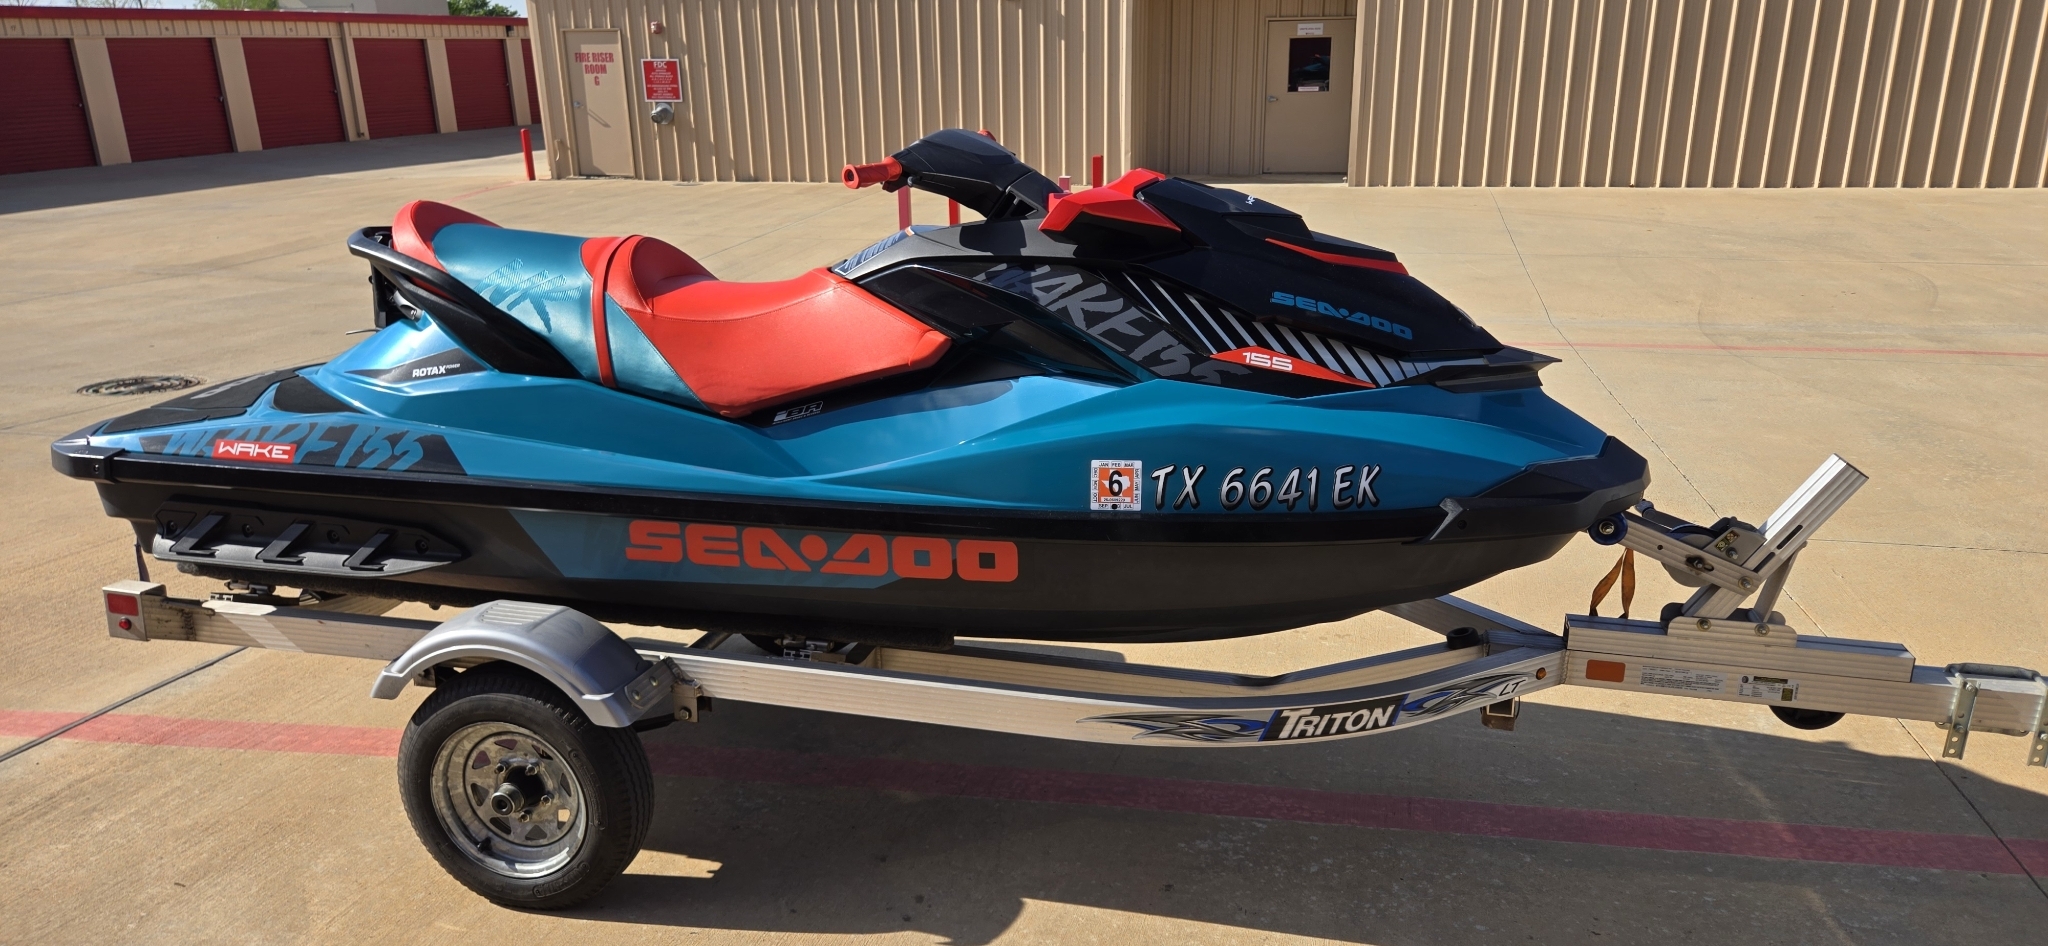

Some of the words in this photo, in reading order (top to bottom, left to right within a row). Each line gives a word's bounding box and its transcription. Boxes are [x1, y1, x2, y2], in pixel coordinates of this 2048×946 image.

[574, 52, 591, 63] FIRE
[591, 52, 614, 63] RISER
[653, 61, 667, 69] FDC
[584, 64, 607, 75] ROOM
[594, 76, 600, 86] G
[1242, 352, 1293, 372] 155
[412, 365, 446, 378] ROTAX
[218, 441, 292, 460] WAKE
[1108, 470, 1123, 497] 6
[1150, 463, 1206, 510] TX
[1219, 464, 1319, 511] 6641
[1332, 463, 1382, 510] EK
[1498, 679, 1527, 697] LT
[1277, 704, 1396, 739] TRITON
